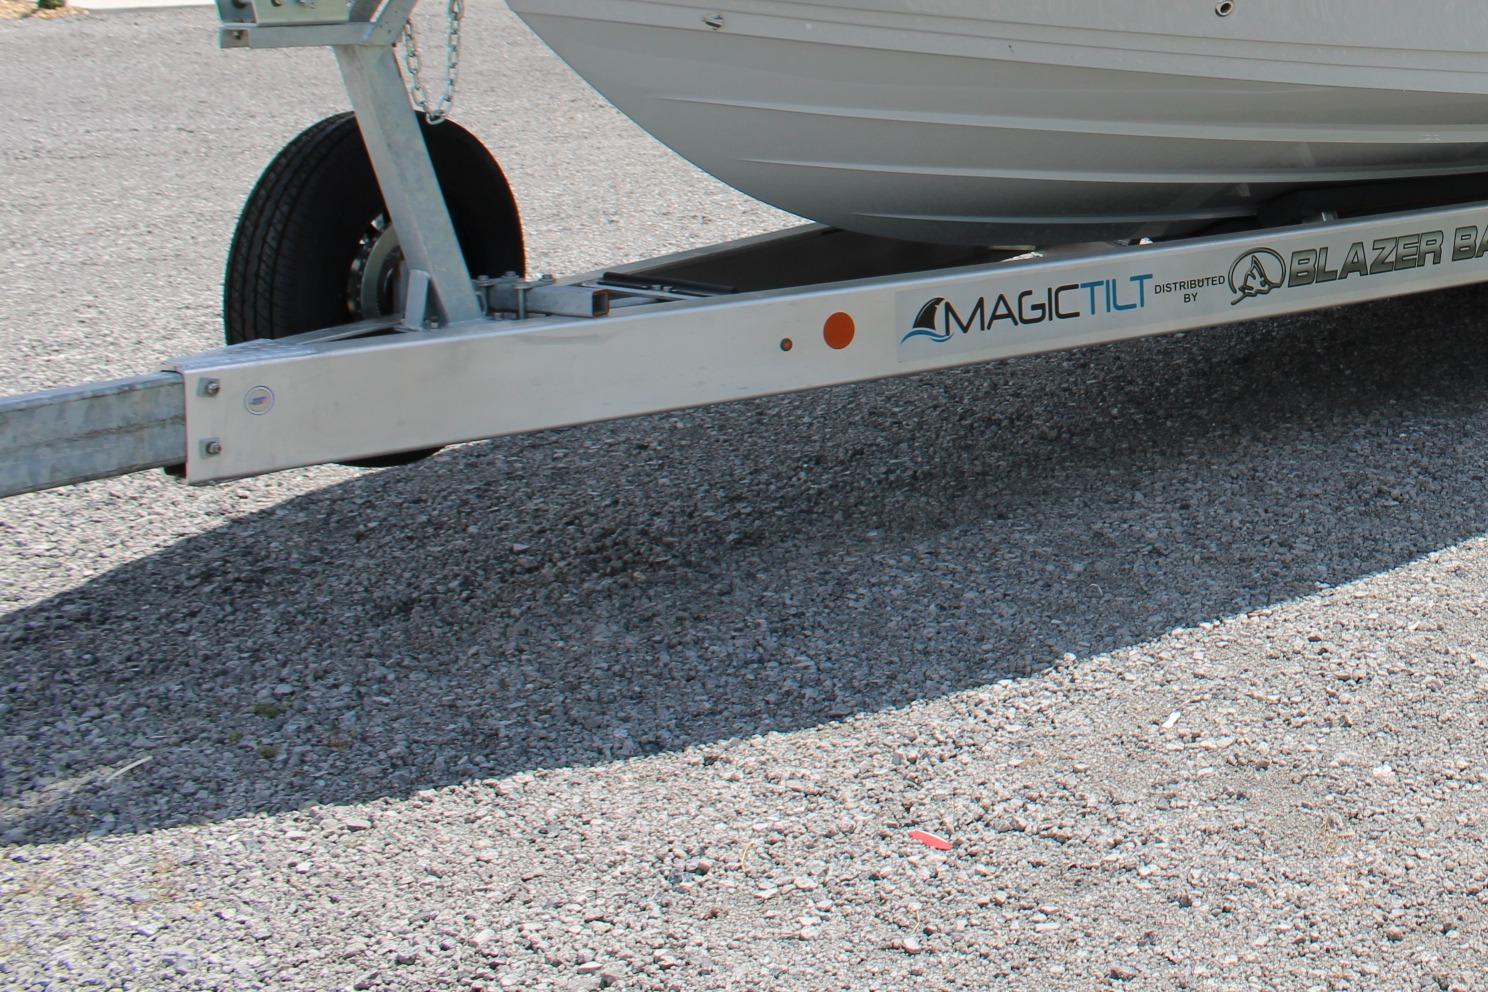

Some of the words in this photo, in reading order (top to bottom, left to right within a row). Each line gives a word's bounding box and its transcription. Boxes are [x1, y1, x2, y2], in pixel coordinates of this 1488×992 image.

[1287, 230, 1444, 288] BLAZER
[1154, 274, 1226, 295] DISTRIBUTED
[1183, 292, 1198, 303] BY
[944, 273, 1153, 336] MAGICTILT
